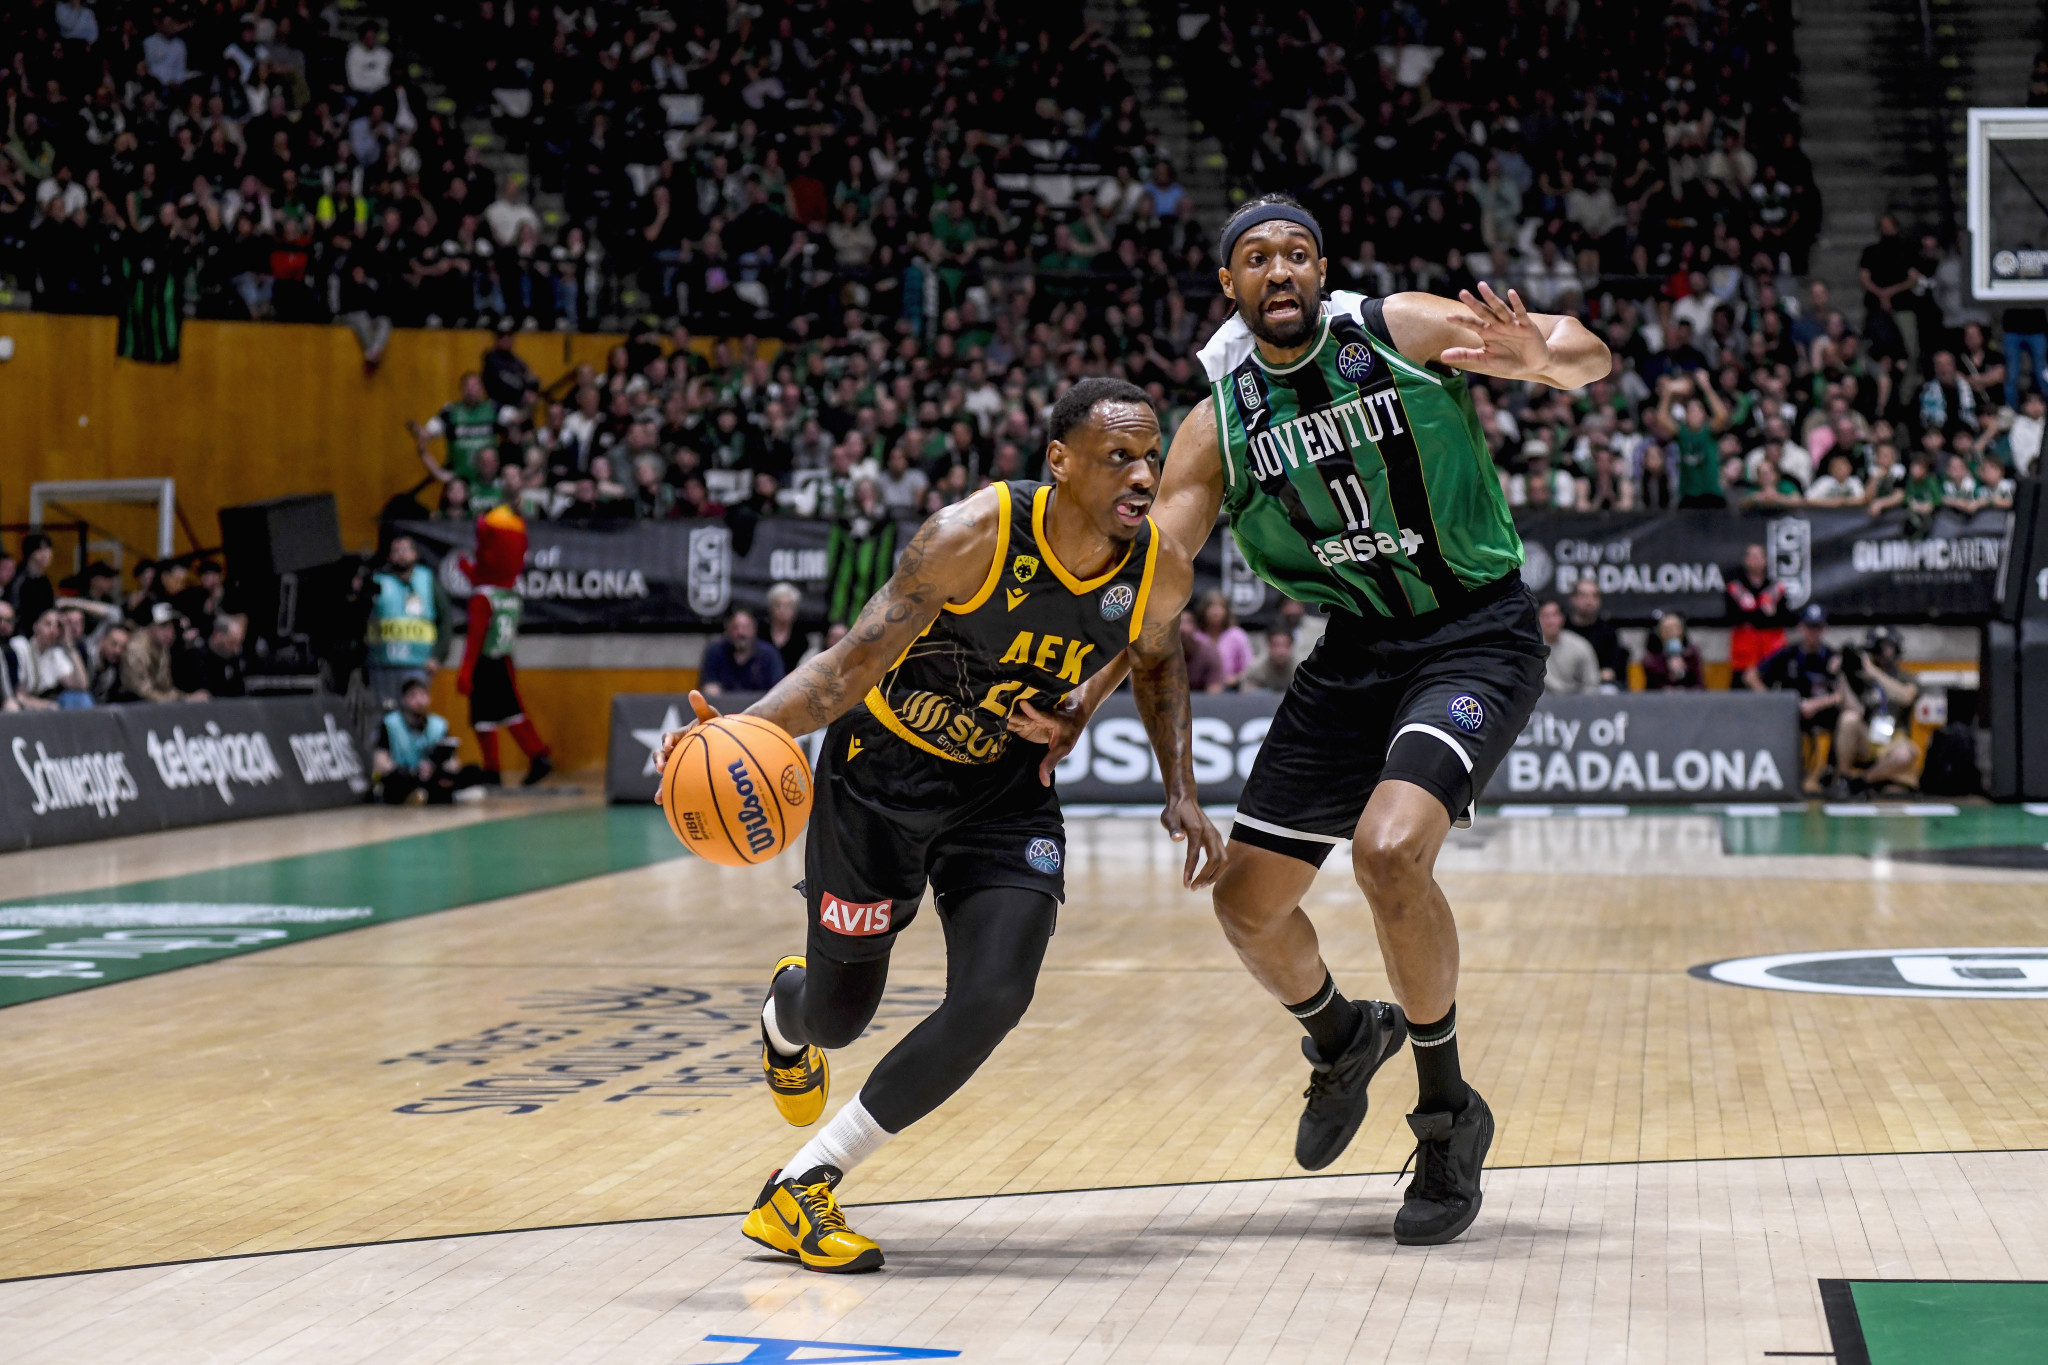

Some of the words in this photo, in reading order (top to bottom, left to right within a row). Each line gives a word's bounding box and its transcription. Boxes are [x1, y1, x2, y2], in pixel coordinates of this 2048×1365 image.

[1249, 387, 1404, 482] JOVENTUT
[1330, 474, 1371, 531] 11
[1312, 531, 1399, 567] asisa
[1605, 538, 1633, 562] of
[513, 569, 649, 599] ADALONA
[999, 631, 1095, 685] AEK
[1589, 711, 1629, 747] of
[11, 736, 139, 819] Schweppes
[146, 720, 284, 806] telepizza
[1508, 750, 1784, 792] BADALONA
[727, 757, 775, 855] Wilson
[683, 811, 703, 841] FIBA
[822, 899, 889, 932] AVIS
